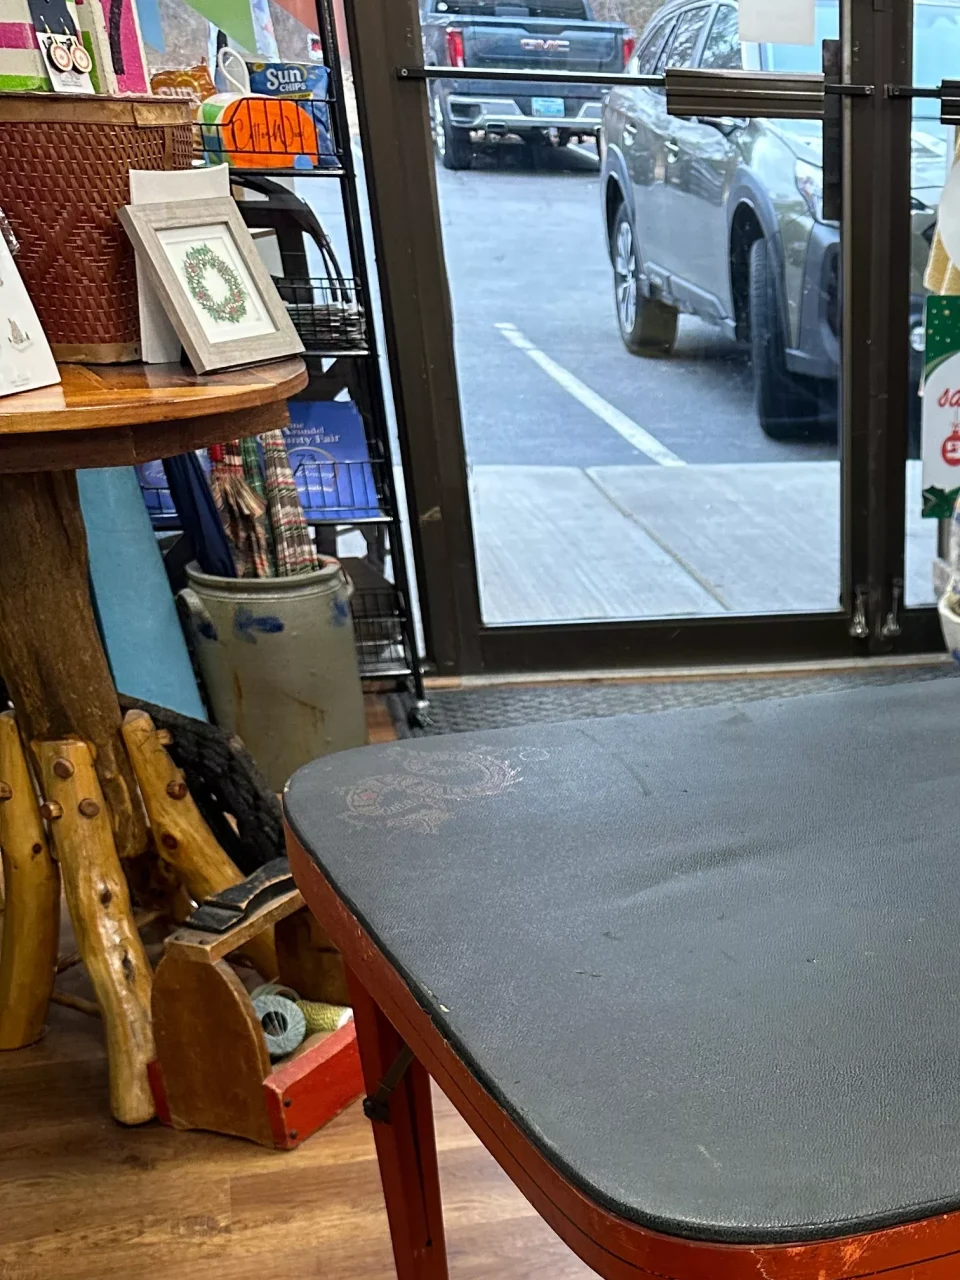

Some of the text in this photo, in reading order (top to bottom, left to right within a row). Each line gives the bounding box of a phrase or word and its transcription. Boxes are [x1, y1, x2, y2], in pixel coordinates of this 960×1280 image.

[521, 38, 570, 51] GMC
[266, 68, 302, 90] Sun
[279, 82, 306, 92] CHIPS
